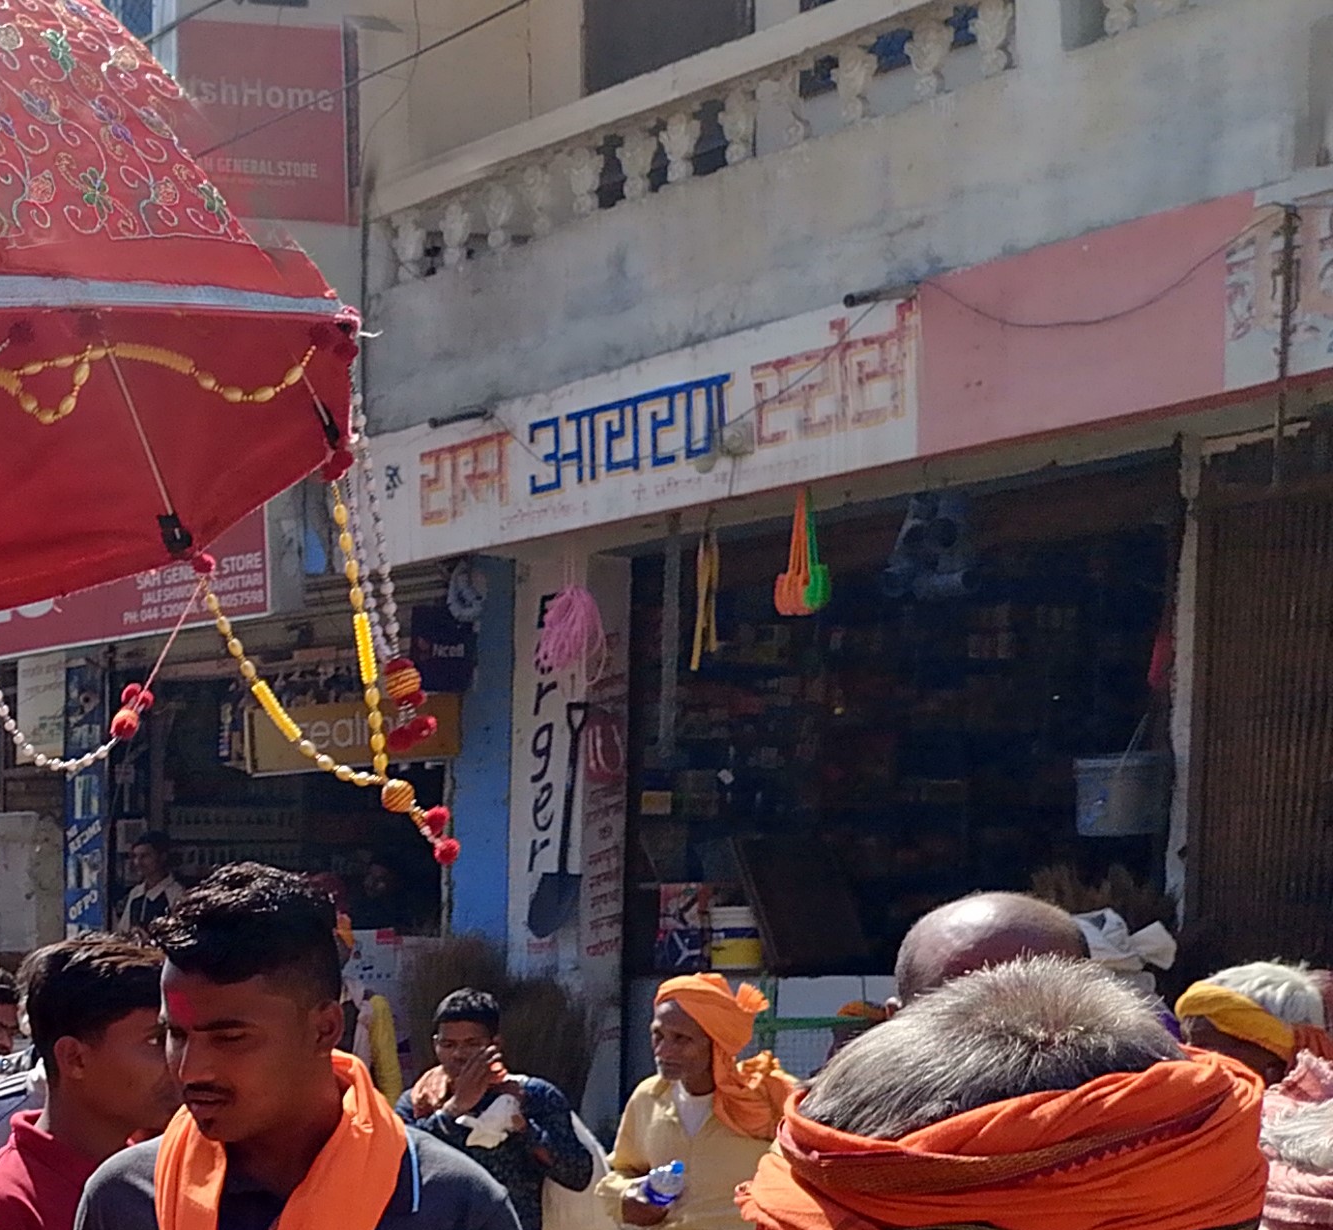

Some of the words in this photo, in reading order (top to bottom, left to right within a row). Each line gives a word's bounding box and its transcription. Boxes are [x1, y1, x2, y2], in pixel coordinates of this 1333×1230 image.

[216, 157, 275, 175] GENERAL
[277, 162, 318, 178] STORE
[136, 570, 161, 590] SAH
[163, 561, 220, 585] GENEL
[222, 552, 262, 574] STORE
